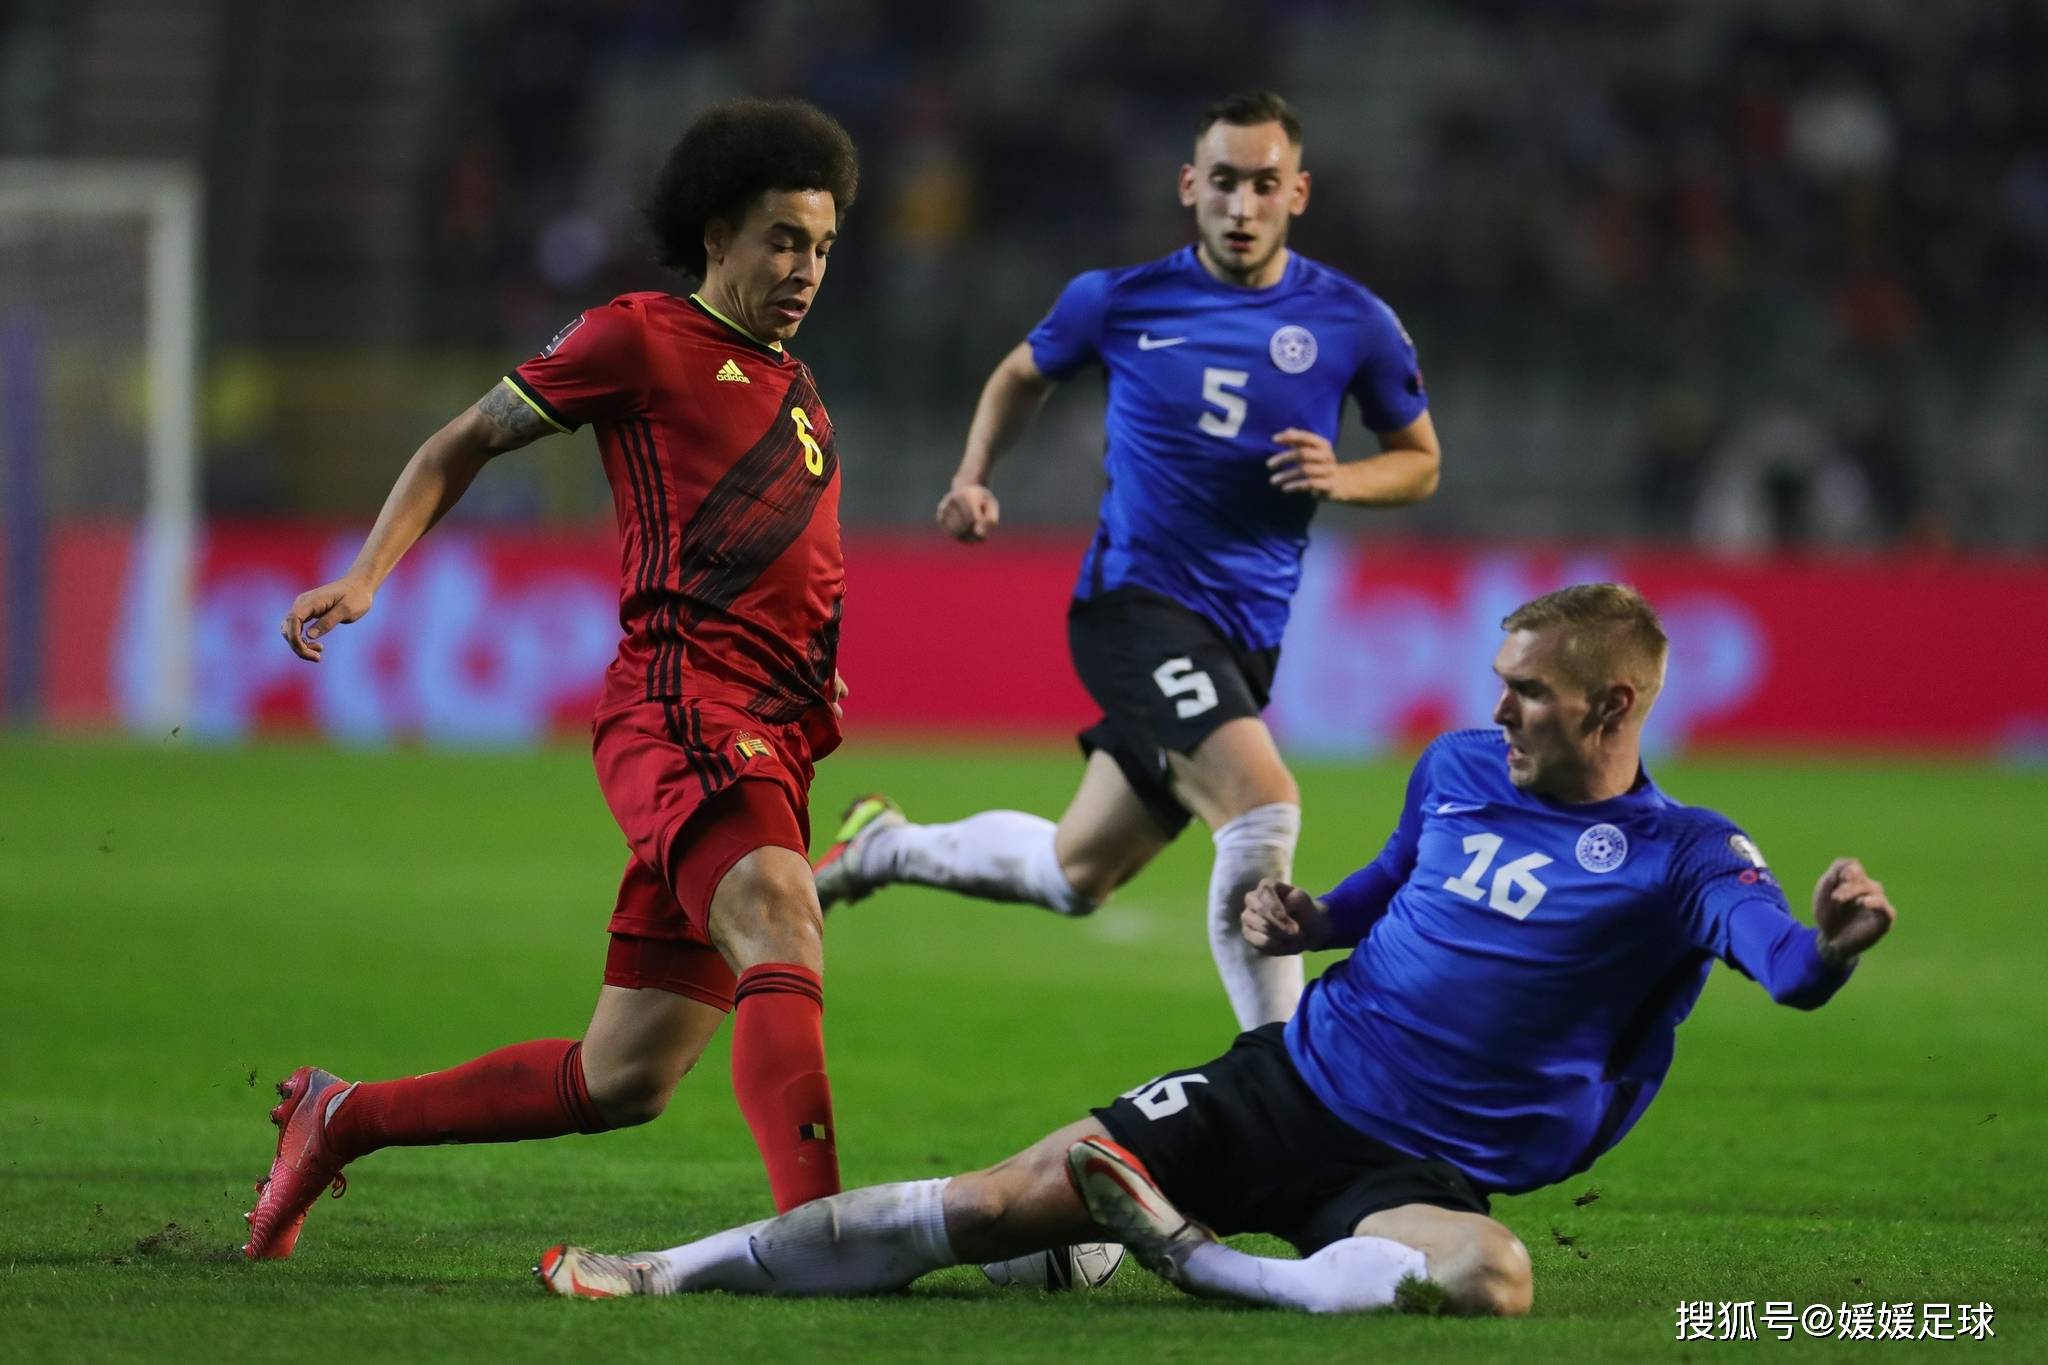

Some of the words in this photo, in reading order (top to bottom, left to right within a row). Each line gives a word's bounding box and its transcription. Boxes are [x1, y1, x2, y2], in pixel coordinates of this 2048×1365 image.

[716, 373, 750, 384] adidas
[1198, 366, 1249, 438] 5
[790, 406, 824, 477] 6
[1152, 656, 1219, 720] 5
[1442, 832, 1554, 921] 16
